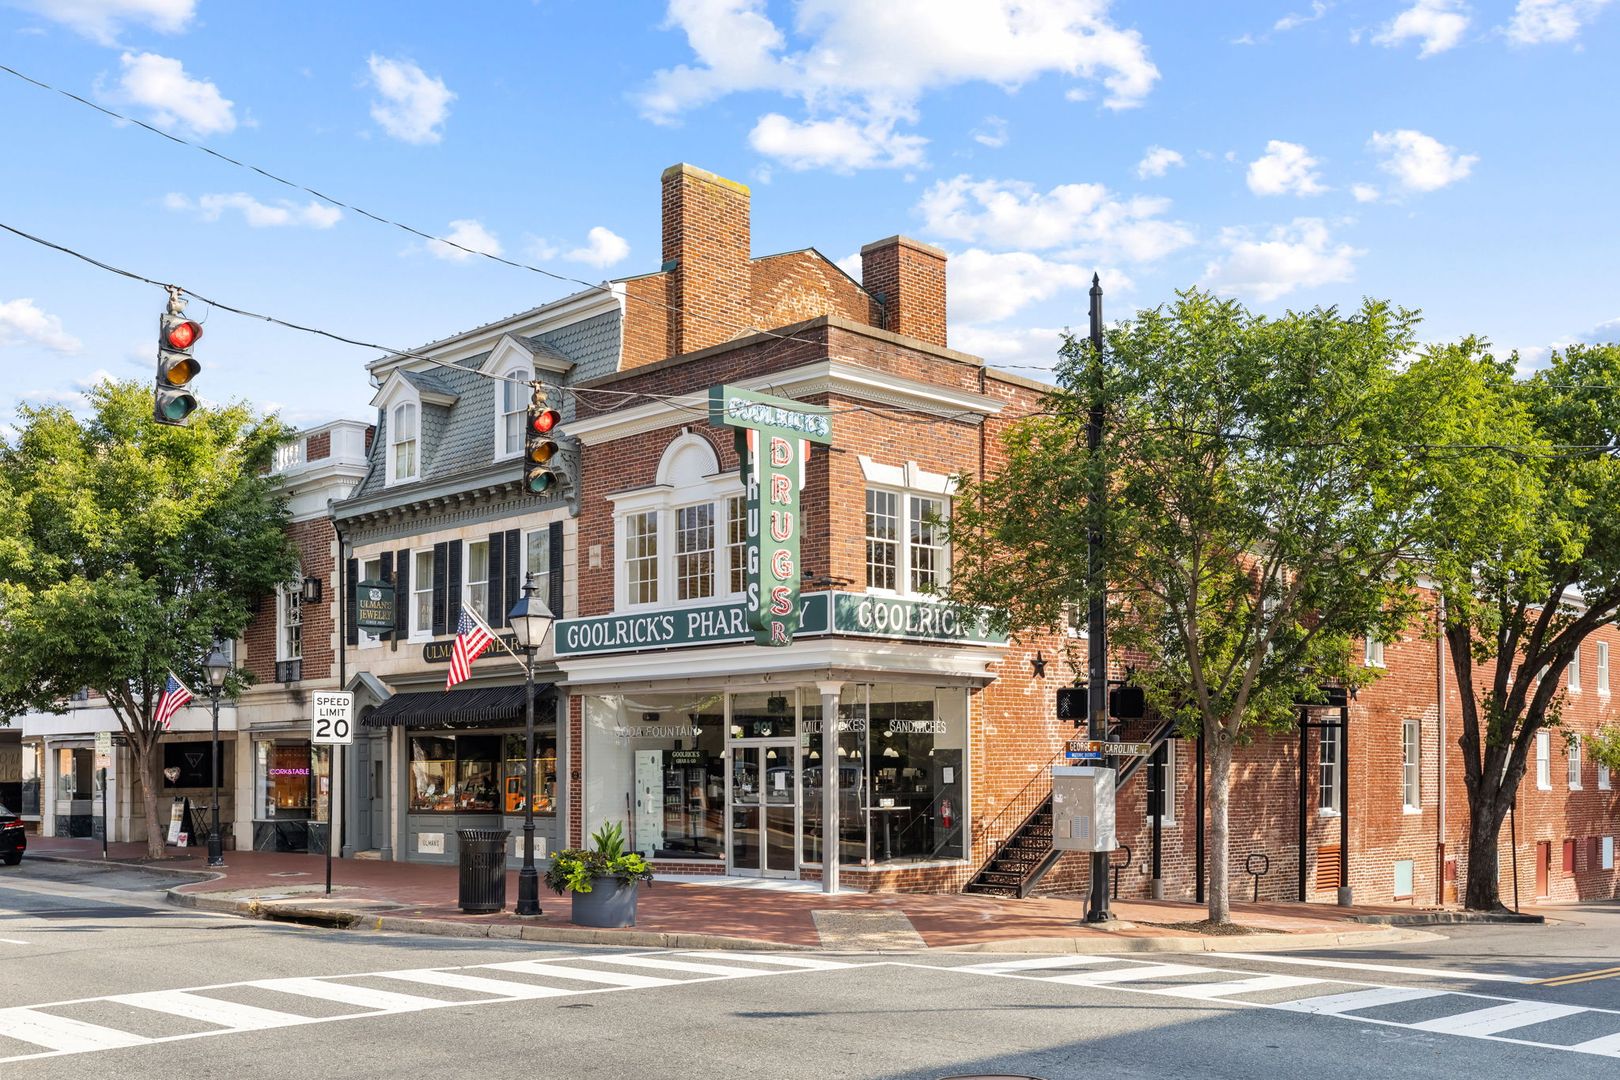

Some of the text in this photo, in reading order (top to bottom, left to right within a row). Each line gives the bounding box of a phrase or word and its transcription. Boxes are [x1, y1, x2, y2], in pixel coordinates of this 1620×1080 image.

[769, 436, 794, 616] DRUGS
[747, 462, 759, 612] RUGS
[359, 608, 392, 621] JEWELRY
[858, 601, 990, 638] GOOLRICKS
[567, 601, 811, 649] GOOLRICK'S PHARY
[316, 697, 350, 706] SPEED
[319, 708, 346, 717] LIMIT
[316, 718, 349, 738] 20
[645, 723, 699, 738] FOUNTAIN
[889, 719, 947, 733] SANDWICHES
[1069, 742, 1091, 751] GEORGE
[1104, 744, 1139, 754] CAROLINE
